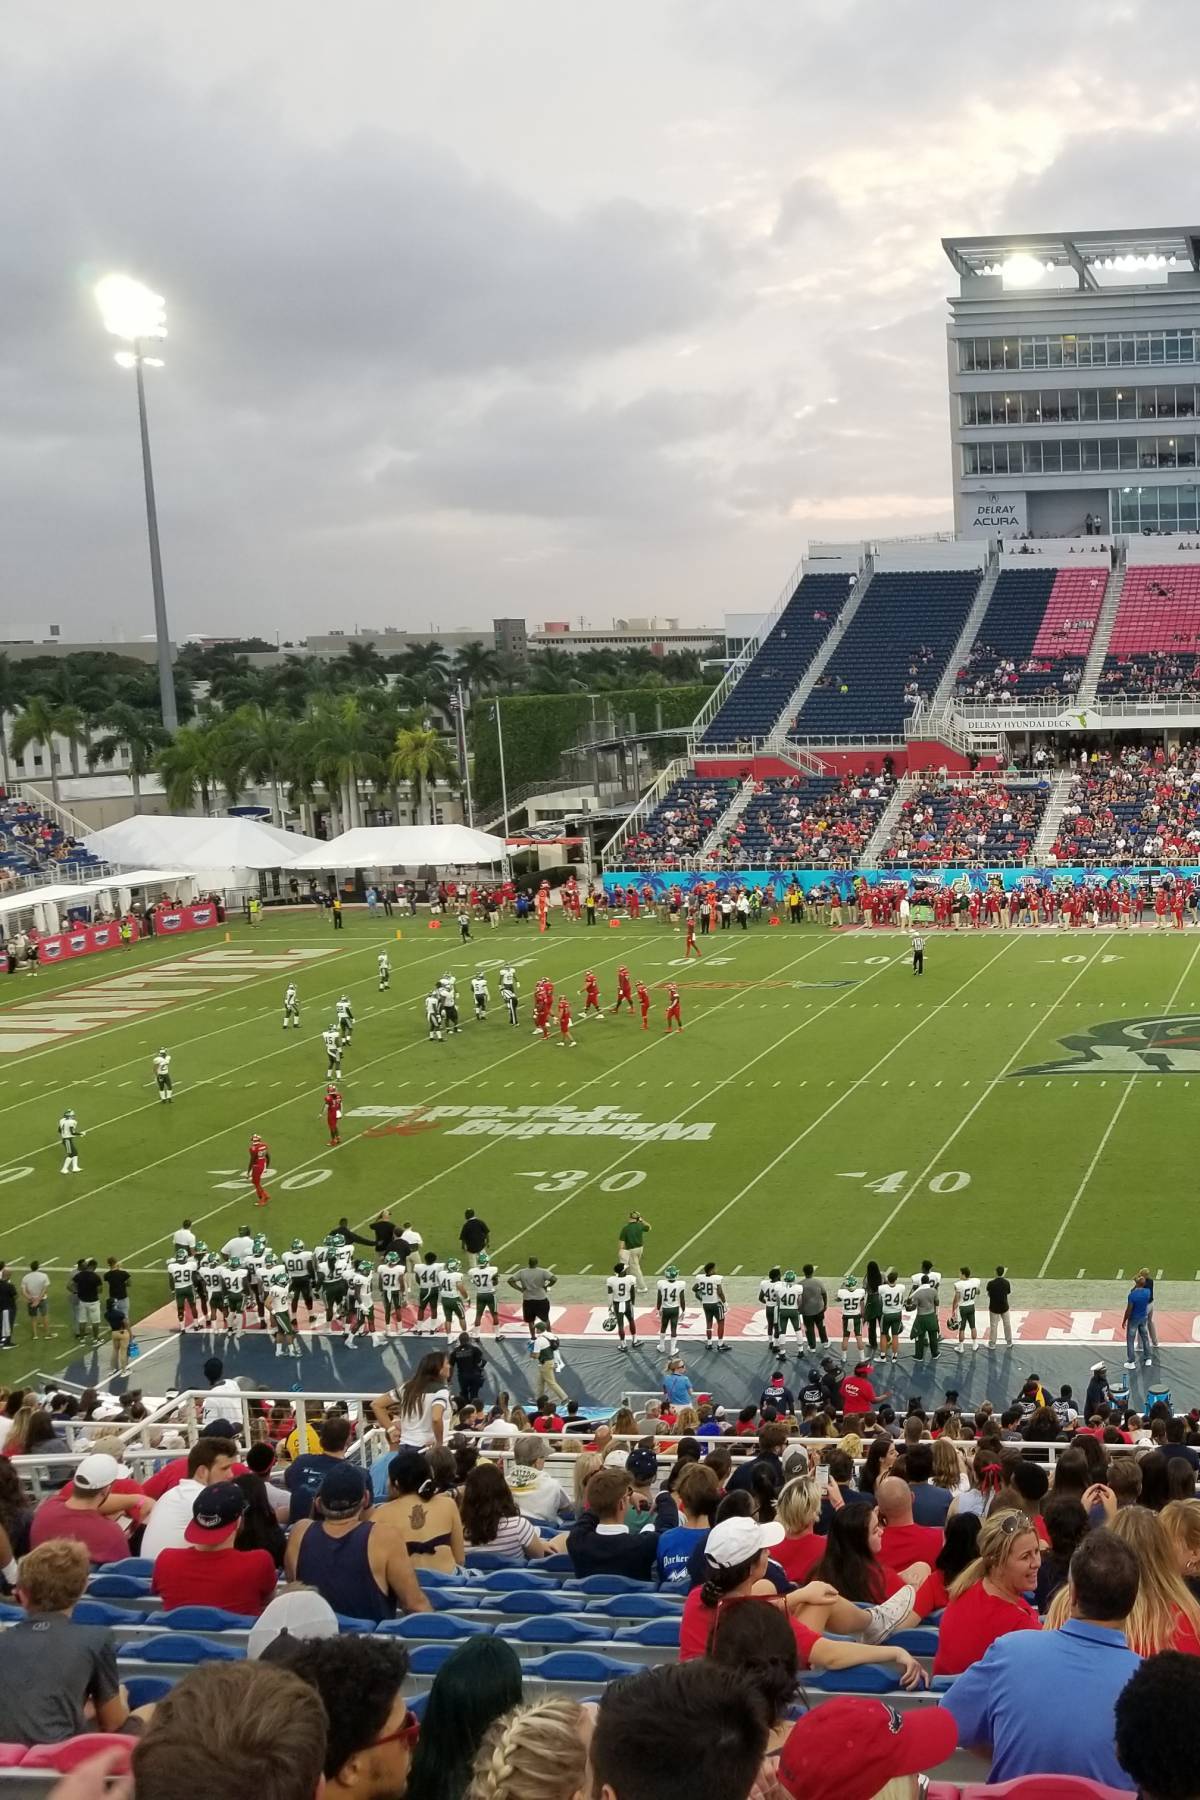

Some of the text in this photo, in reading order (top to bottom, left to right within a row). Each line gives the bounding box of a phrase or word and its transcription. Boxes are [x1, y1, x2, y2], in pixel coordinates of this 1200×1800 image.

[977, 505, 1016, 515] DELRAY
[972, 516, 1019, 527] ACURA
[968, 719, 1072, 729] DELRAY HYUNDAI DECK
[1061, 954, 1126, 964] 40
[344, 1105, 622, 1123] Paradise
[442, 1119, 718, 1141] Winning
[532, 1169, 647, 1193] 30
[862, 1170, 973, 1194] 40
[287, 1258, 304, 1271] 90
[174, 1270, 191, 1283] 29
[203, 1274, 219, 1287] 38
[383, 1274, 396, 1287] 31
[420, 1270, 437, 1283] 44
[474, 1274, 488, 1287] 37
[223, 1277, 239, 1290] 34
[440, 1278, 452, 1291] 41
[618, 1283, 626, 1296] 9
[699, 1283, 713, 1295] 28
[663, 1288, 677, 1301] 14
[780, 1293, 795, 1306] 40
[885, 1293, 900, 1307] 24
[962, 1288, 977, 1301] 50
[843, 1298, 860, 1311] 25
